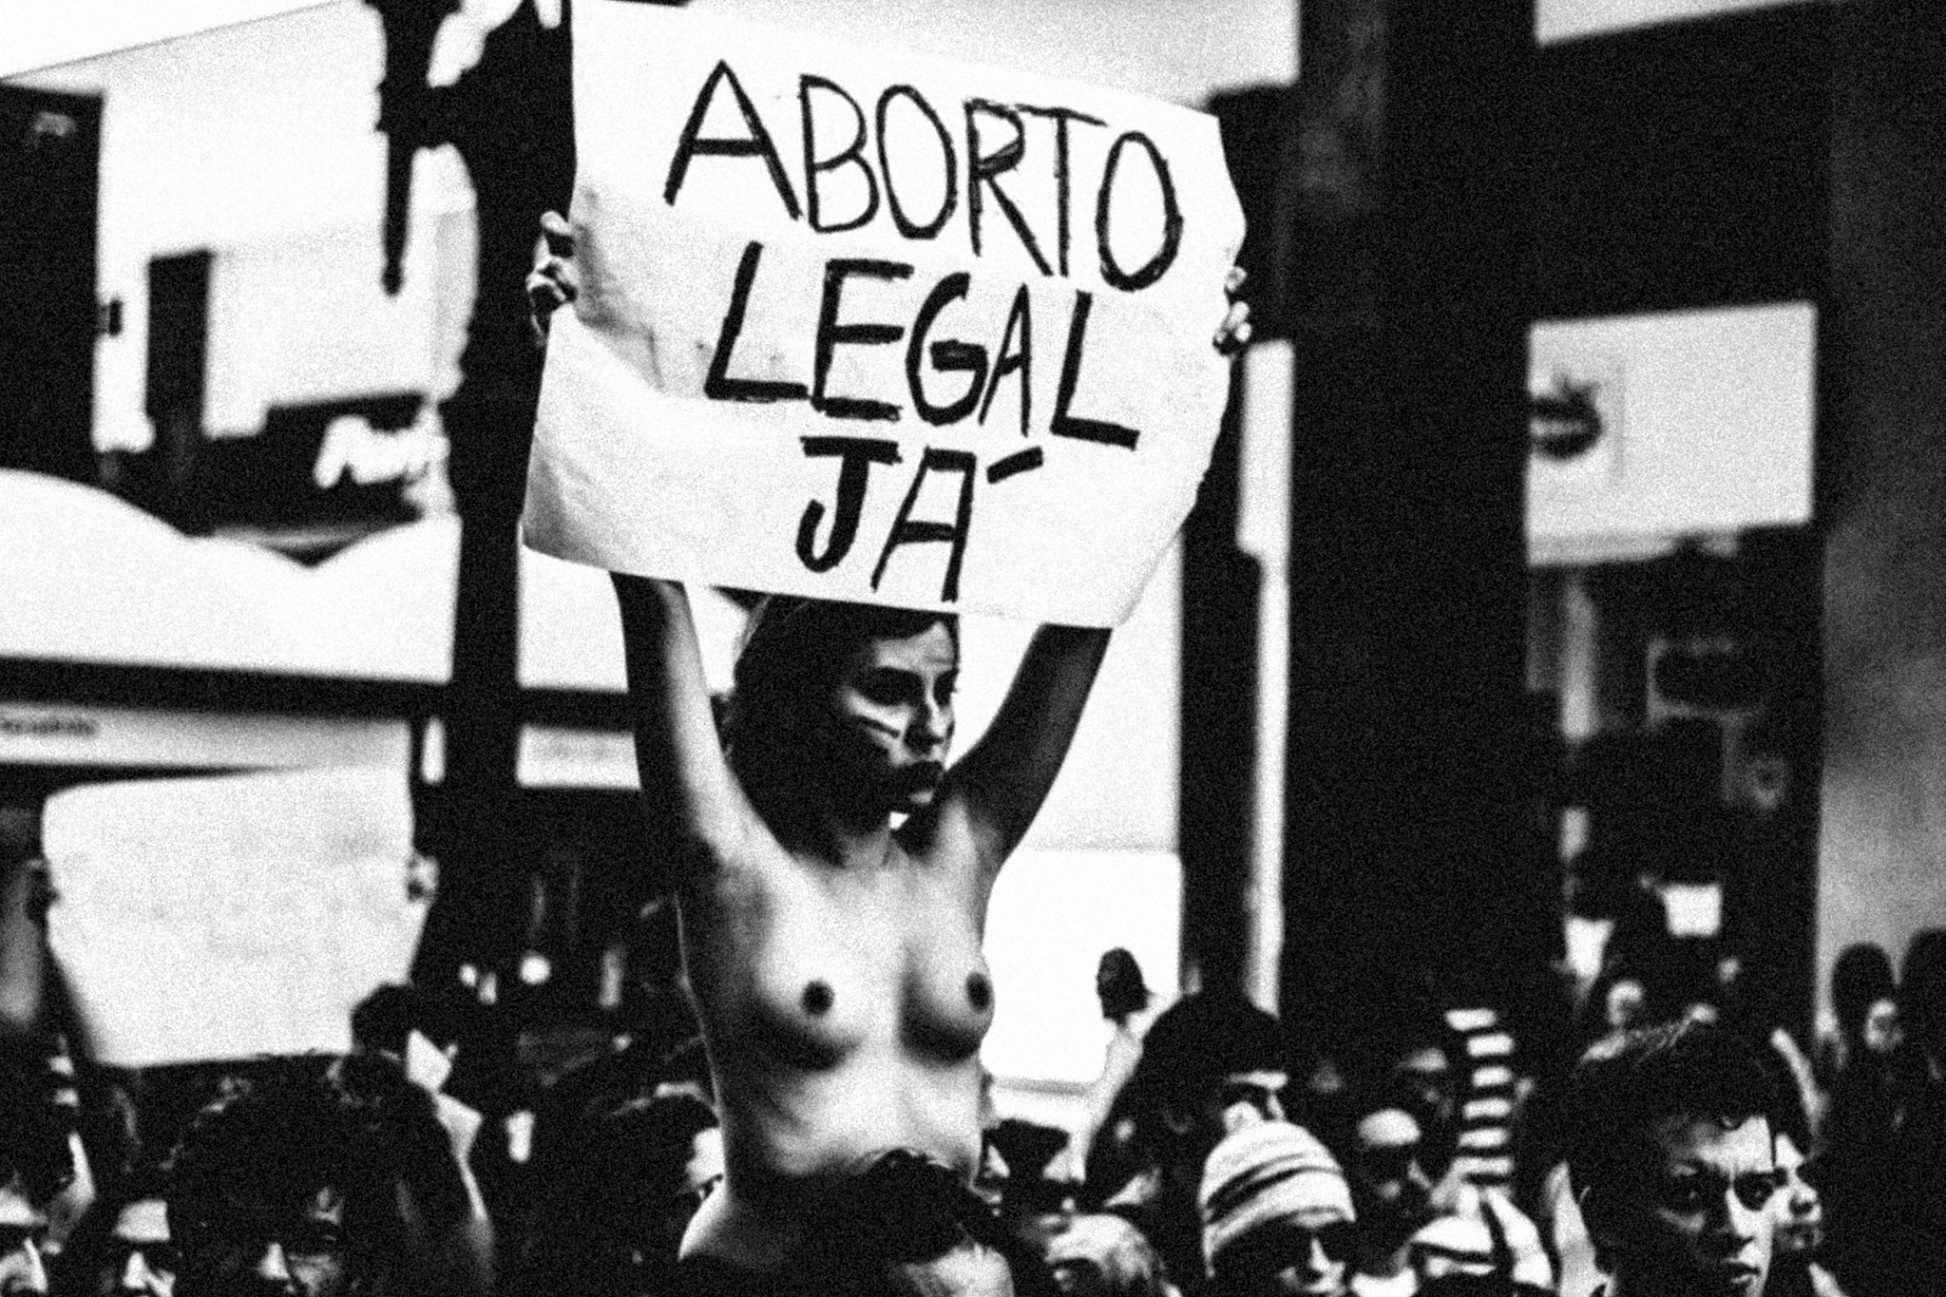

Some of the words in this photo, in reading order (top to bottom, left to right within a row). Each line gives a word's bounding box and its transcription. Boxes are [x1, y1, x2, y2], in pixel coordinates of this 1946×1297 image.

[664, 59, 1183, 291] ABORTO
[704, 241, 1141, 450] LEGAL
[796, 436, 1044, 602] JÁ
